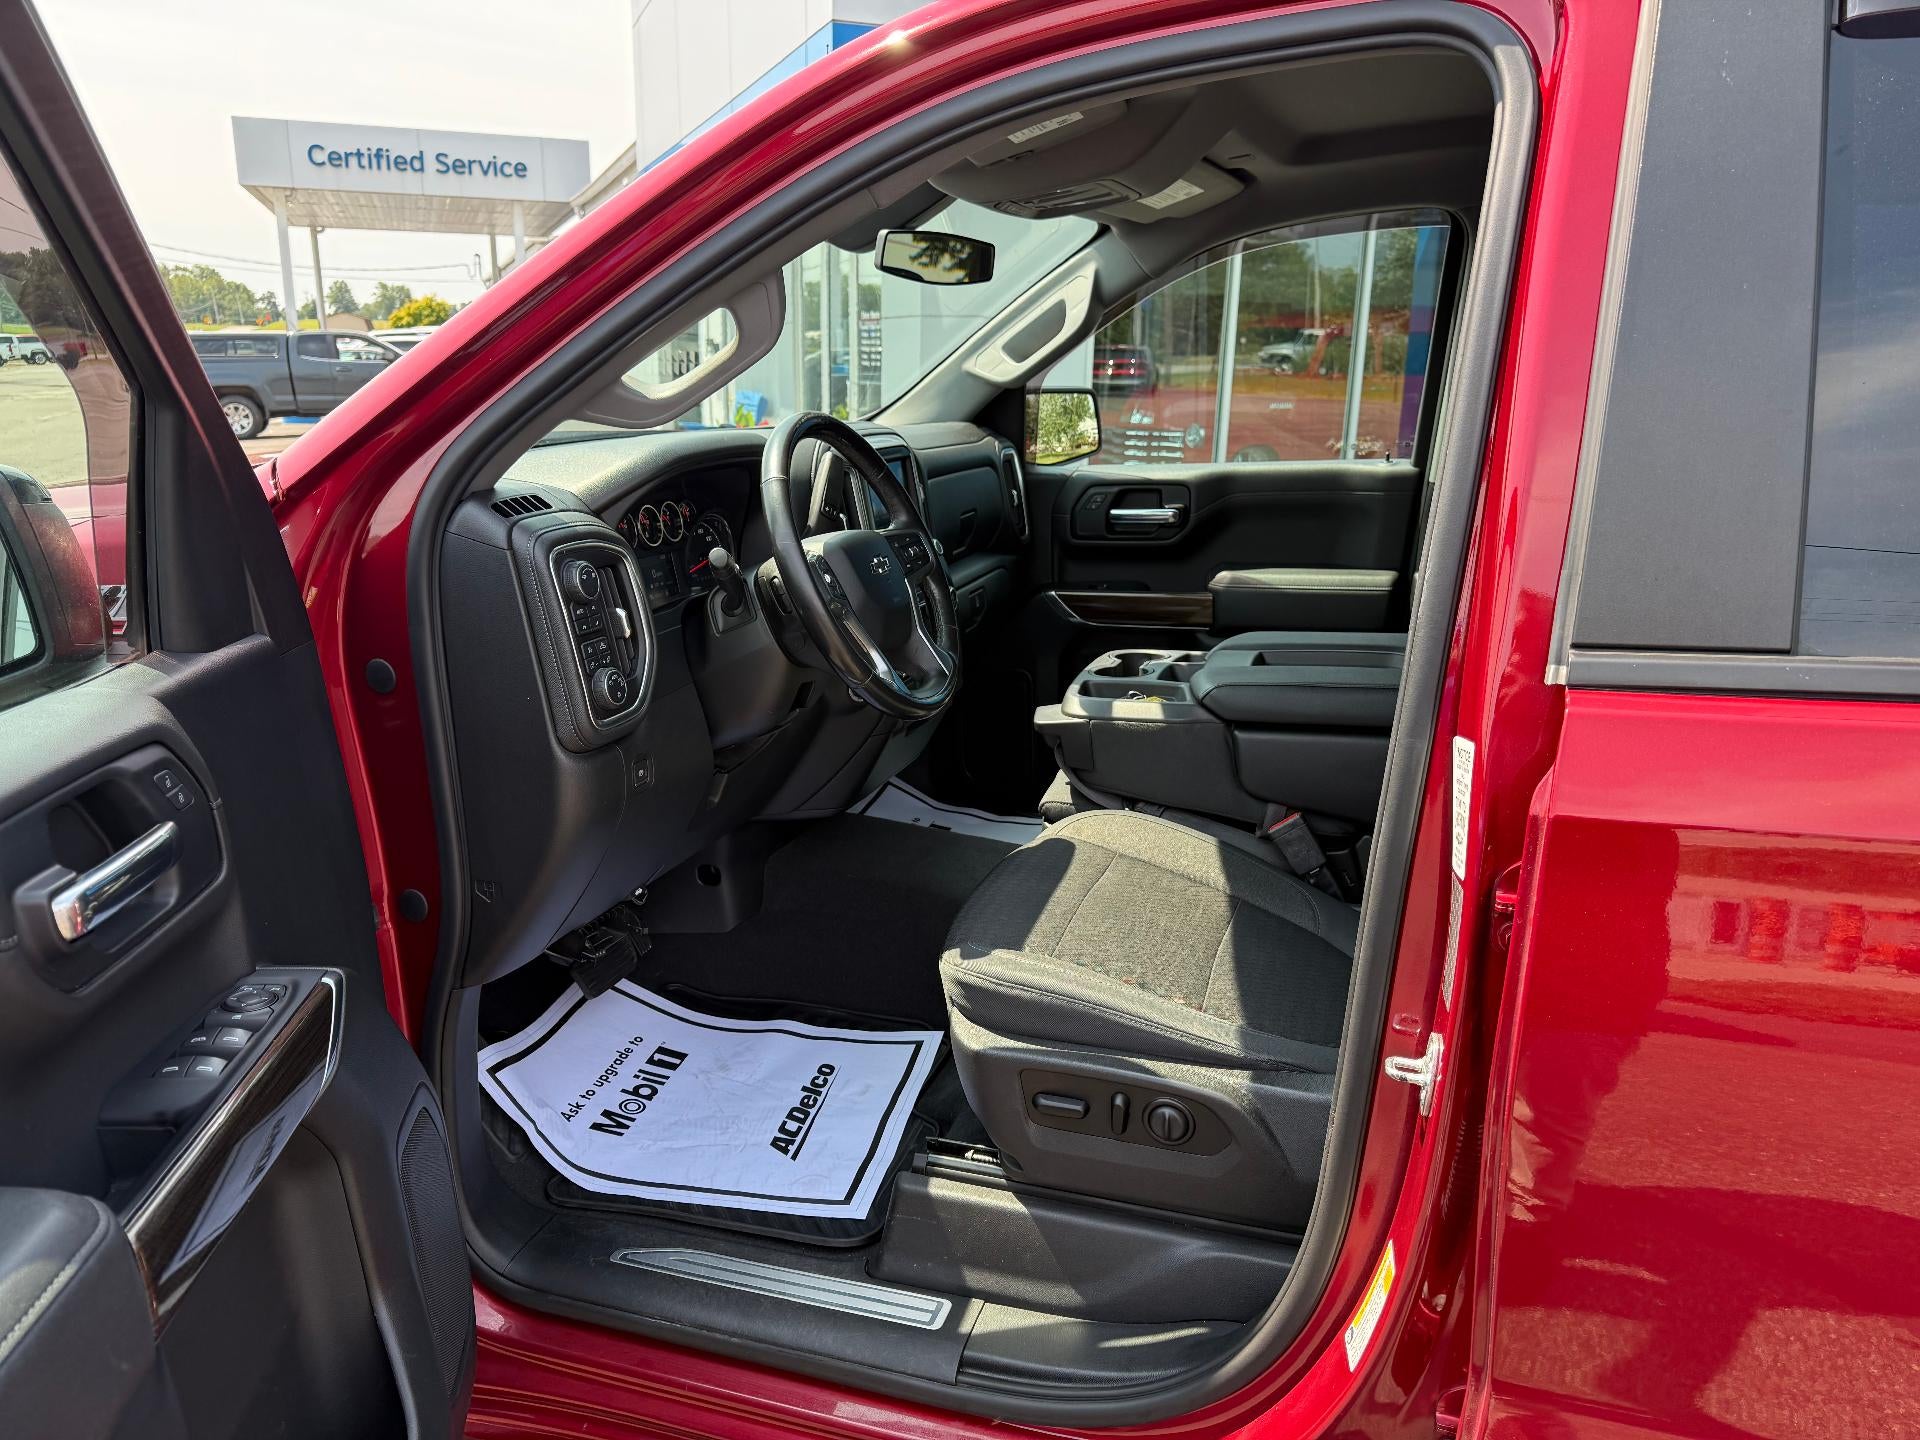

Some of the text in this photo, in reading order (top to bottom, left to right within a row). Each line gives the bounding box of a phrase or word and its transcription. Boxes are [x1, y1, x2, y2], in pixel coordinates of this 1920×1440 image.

[307, 144, 528, 178] Certified Service
[560, 1036, 644, 1123] Ask to upgrade to
[588, 1068, 671, 1137] Mobil
[769, 1063, 836, 1157] ACDelco
